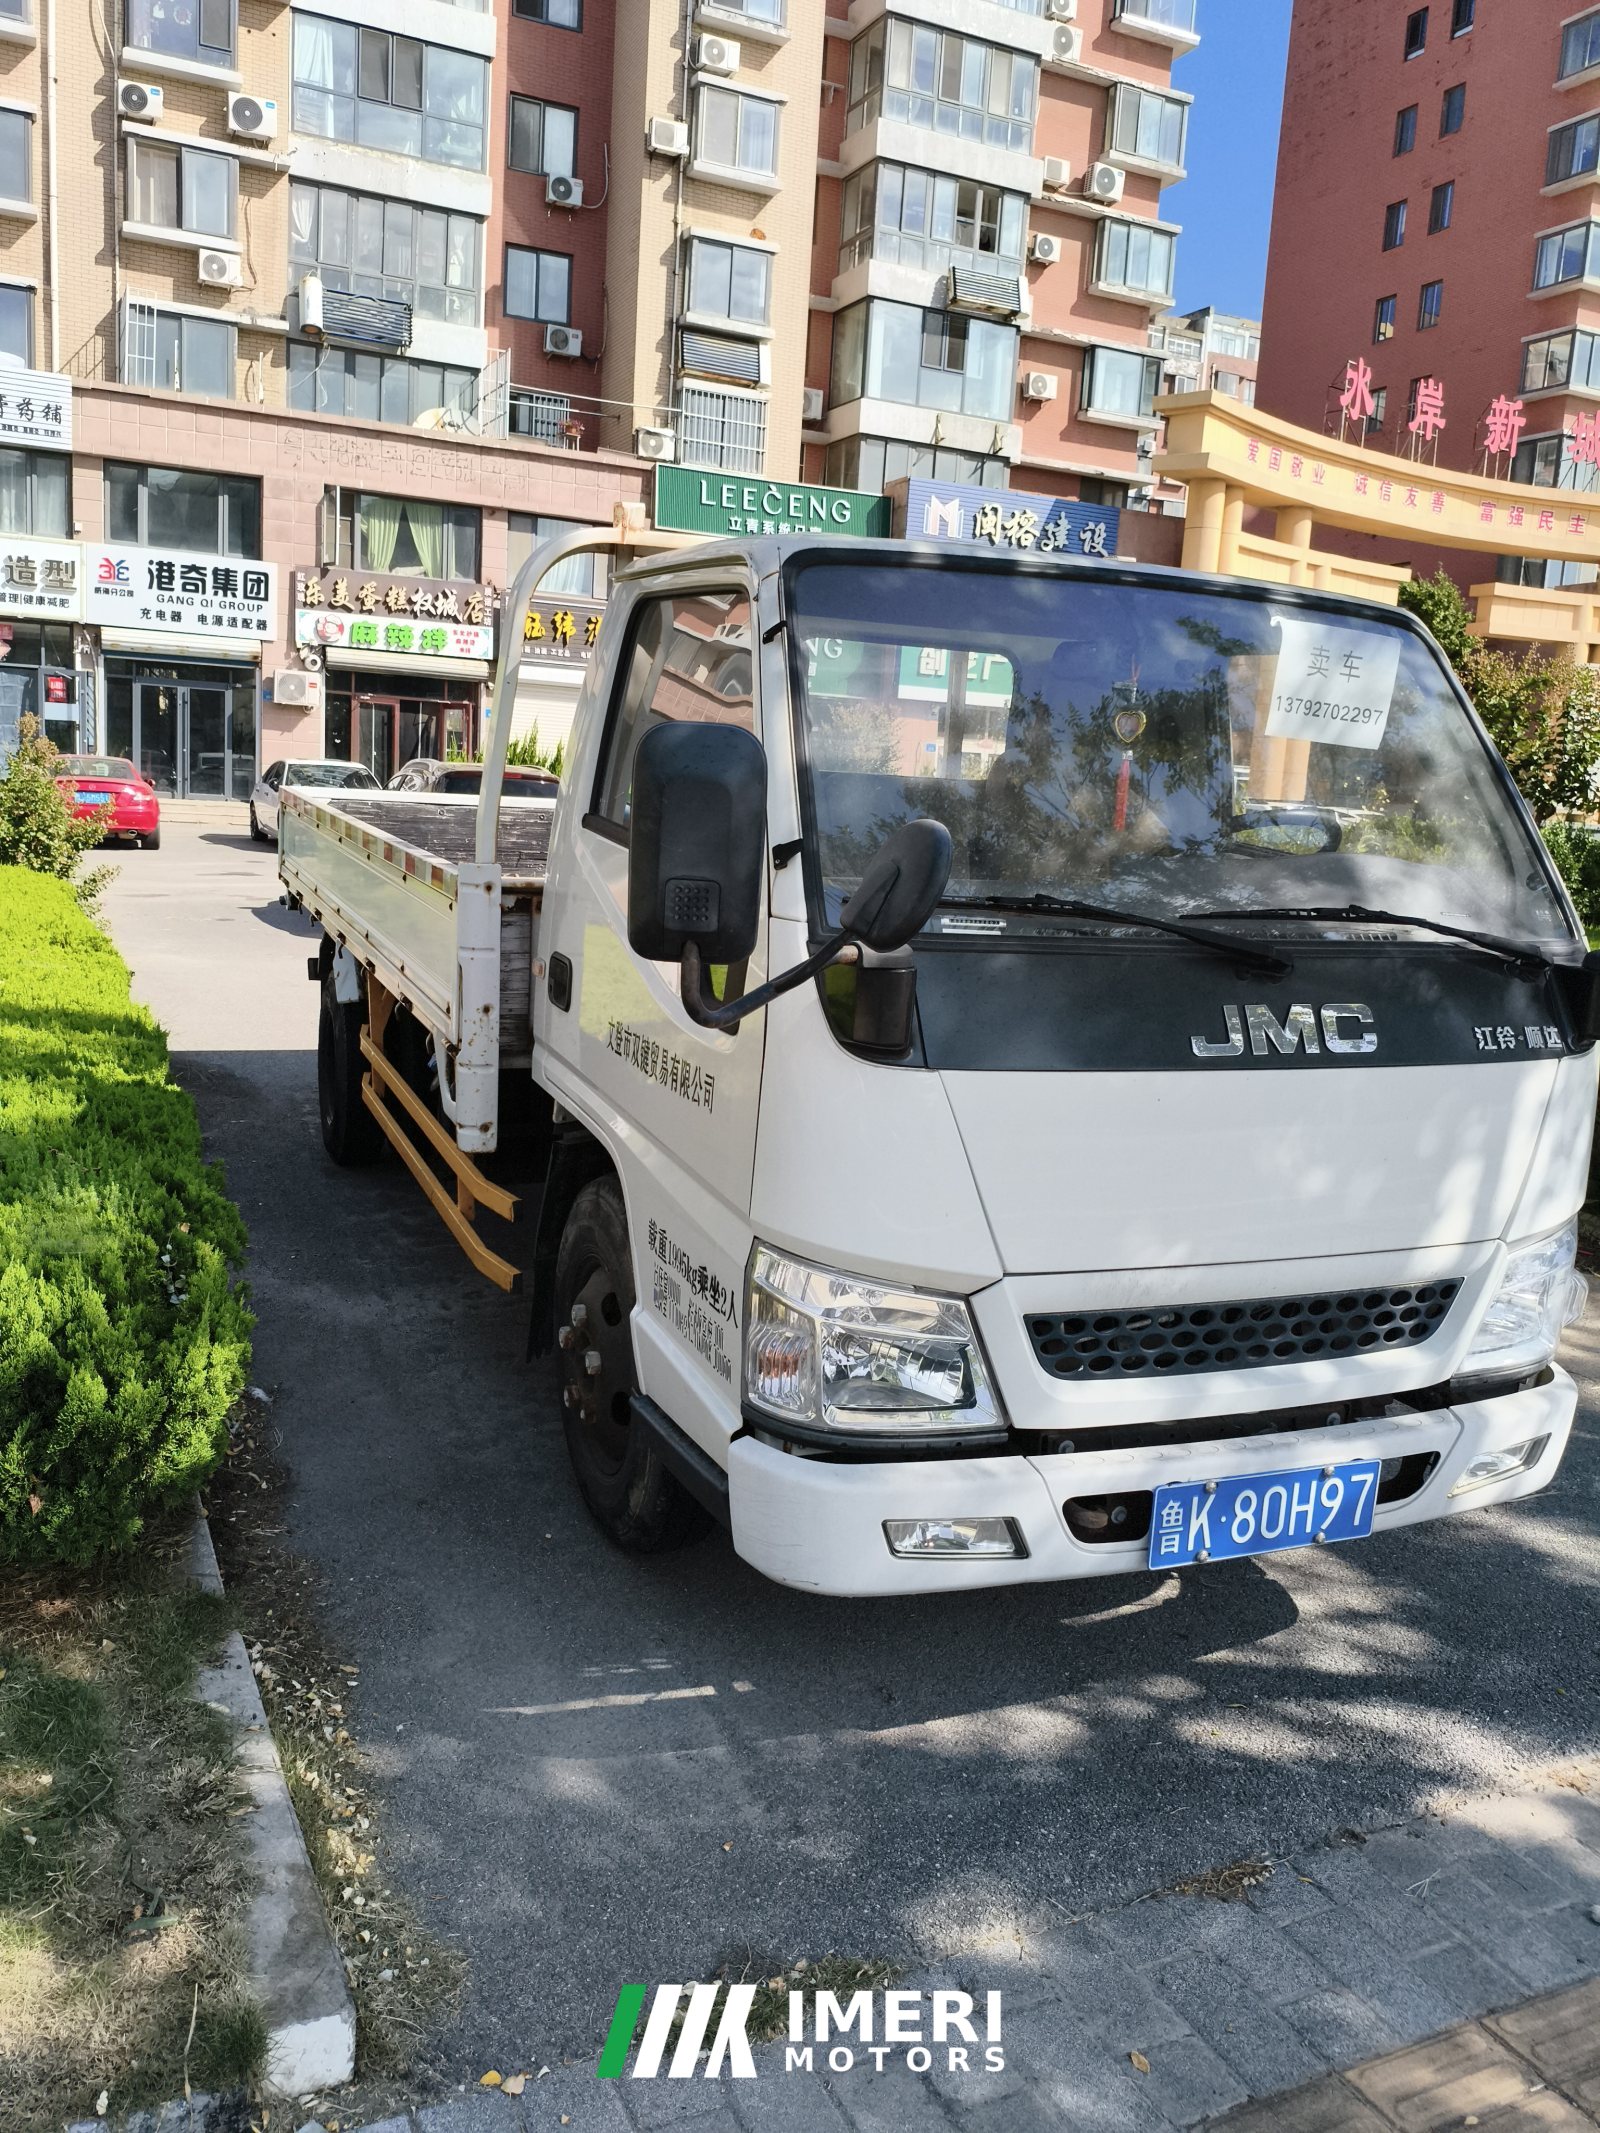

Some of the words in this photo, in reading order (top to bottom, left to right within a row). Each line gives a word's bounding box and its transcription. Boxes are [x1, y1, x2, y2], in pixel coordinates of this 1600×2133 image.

[1340, 357, 1600, 470] 水岸新城
[1248, 437, 1326, 485] 爱国敬业
[1355, 472, 1447, 514] 诚信友善
[1479, 501, 1586, 535] 富强民主
[4, 555, 77, 592] 造型
[147, 560, 269, 602] 港奇集团
[140, 608, 182, 622] 充电器
[198, 613, 267, 631] 电源适配器
[157, 594, 194, 606] GANG
[200, 599, 213, 608] QI
[219, 600, 263, 613] GROUP
[351, 621, 448, 651] 麻辣拌
[1307, 645, 1363, 683] 卖车
[1276, 695, 1383, 726] 13792702297
[1191, 1003, 1378, 1057] JMC
